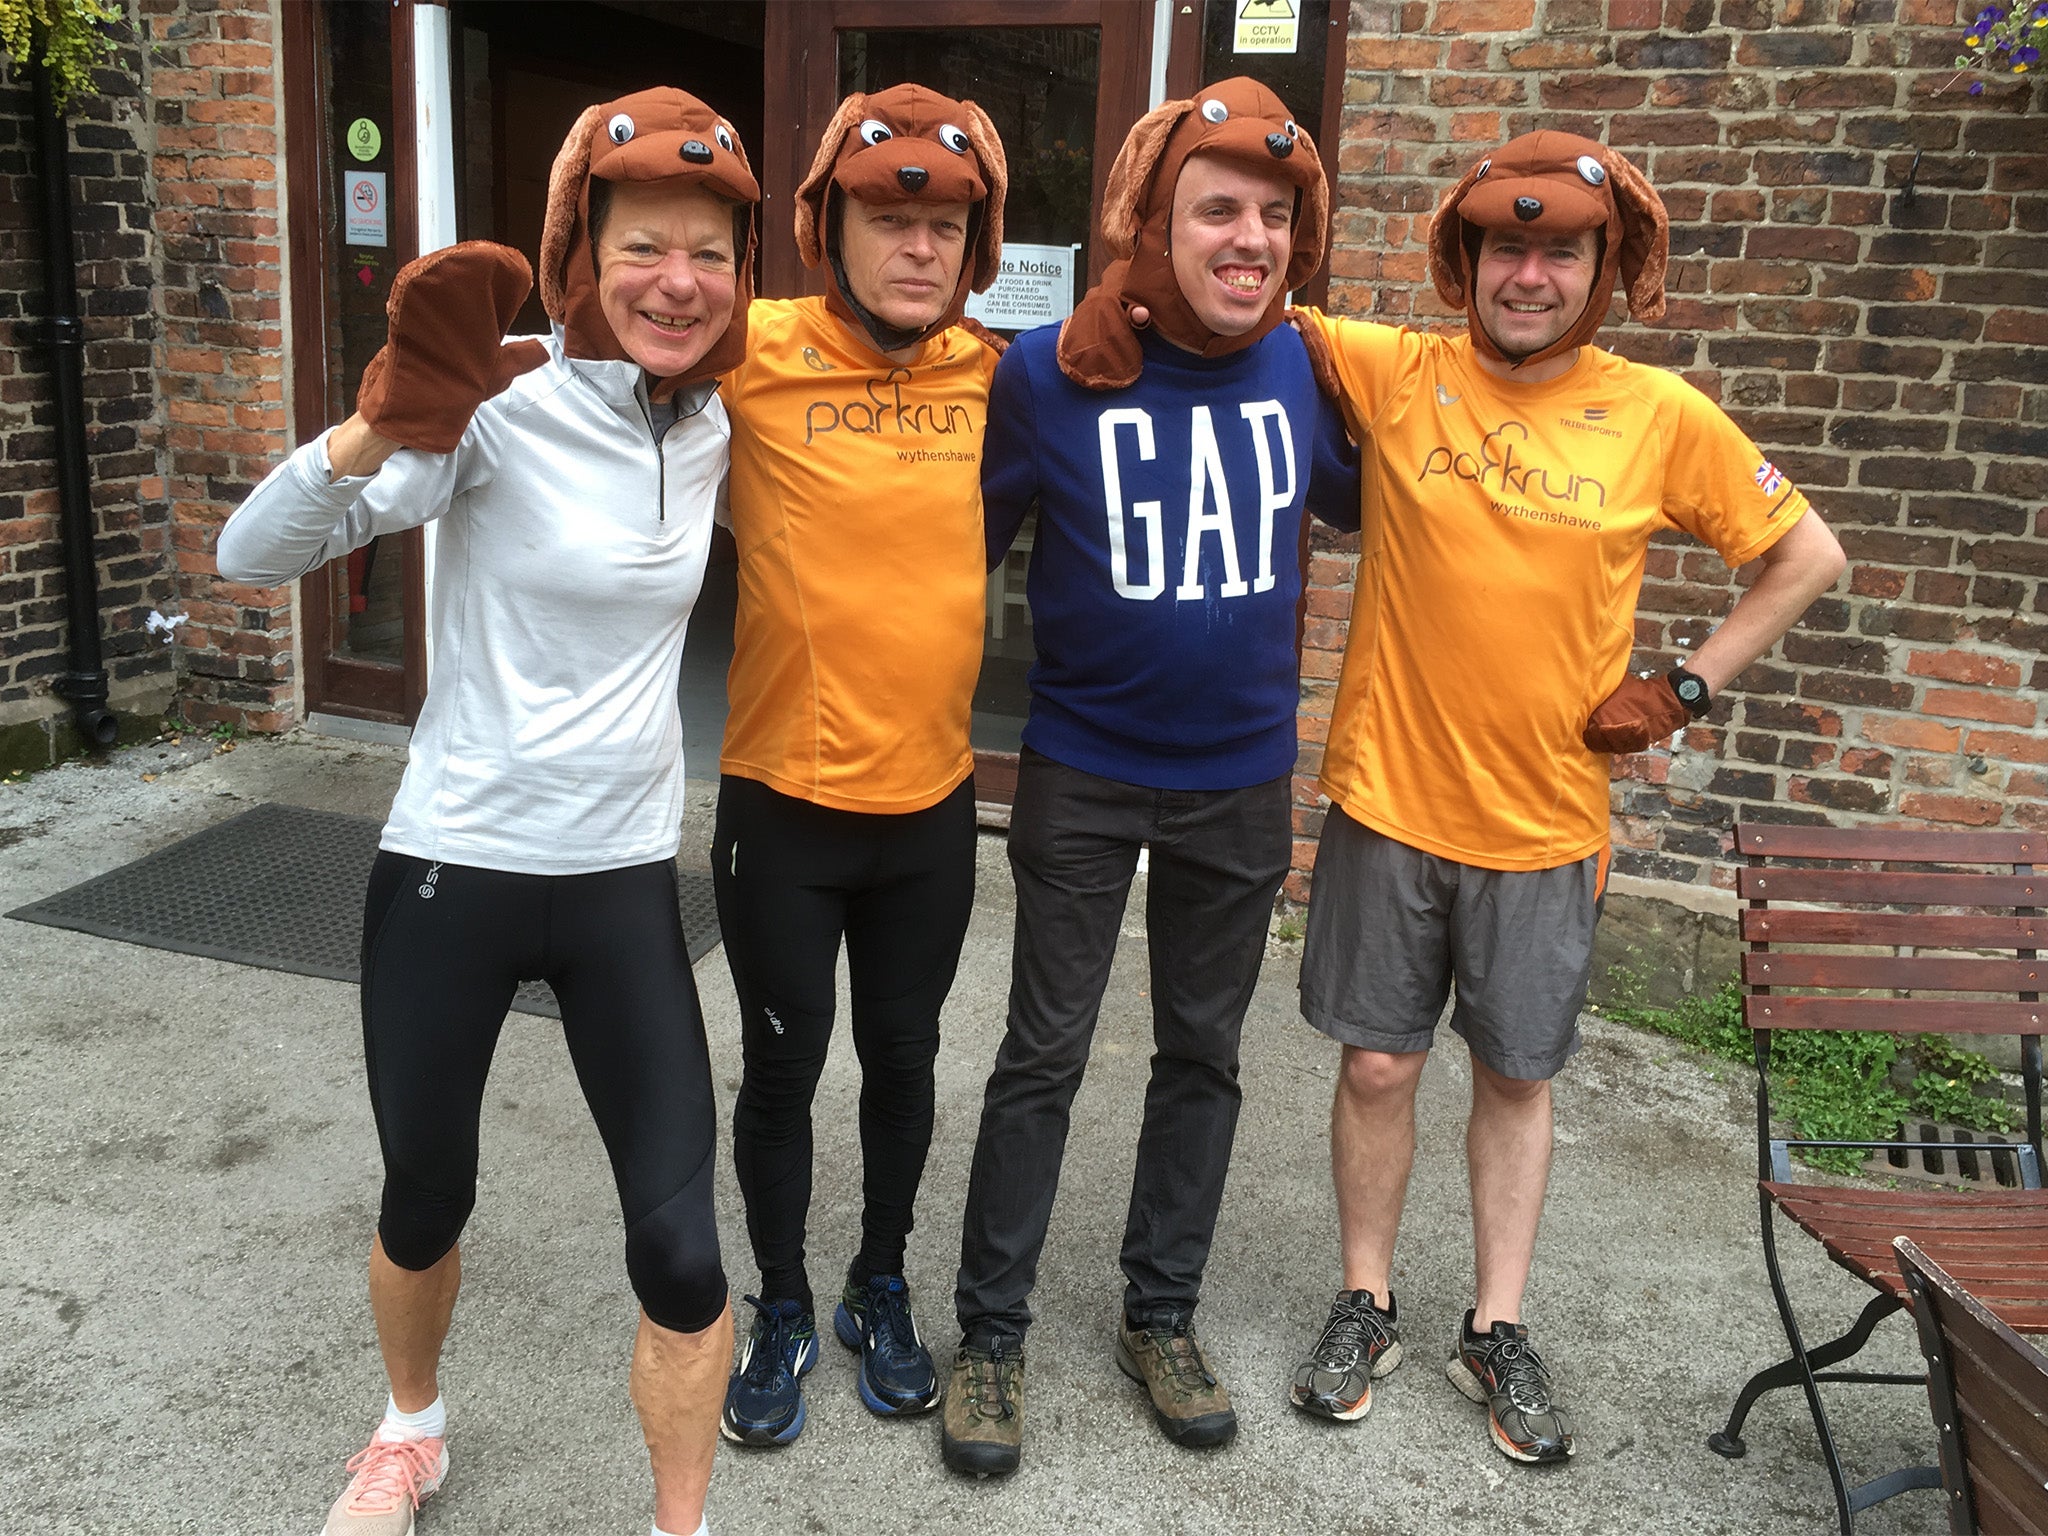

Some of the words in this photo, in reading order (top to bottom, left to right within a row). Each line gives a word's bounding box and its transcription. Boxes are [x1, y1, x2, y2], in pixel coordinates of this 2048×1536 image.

[1252, 25, 1280, 35] CCTV
[1240, 36, 1248, 44] in
[1250, 36, 1291, 46] operation
[1020, 260, 1062, 275] Notice
[998, 286, 1040, 294] PURCHASED
[806, 367, 973, 445] parkrun
[1559, 418, 1623, 438] TRIBESPORTS
[896, 449, 976, 463] wythenshawe
[1417, 421, 1606, 507] parkrun
[1098, 399, 1297, 600] GAP
[1490, 500, 1601, 531] wythenshawe
